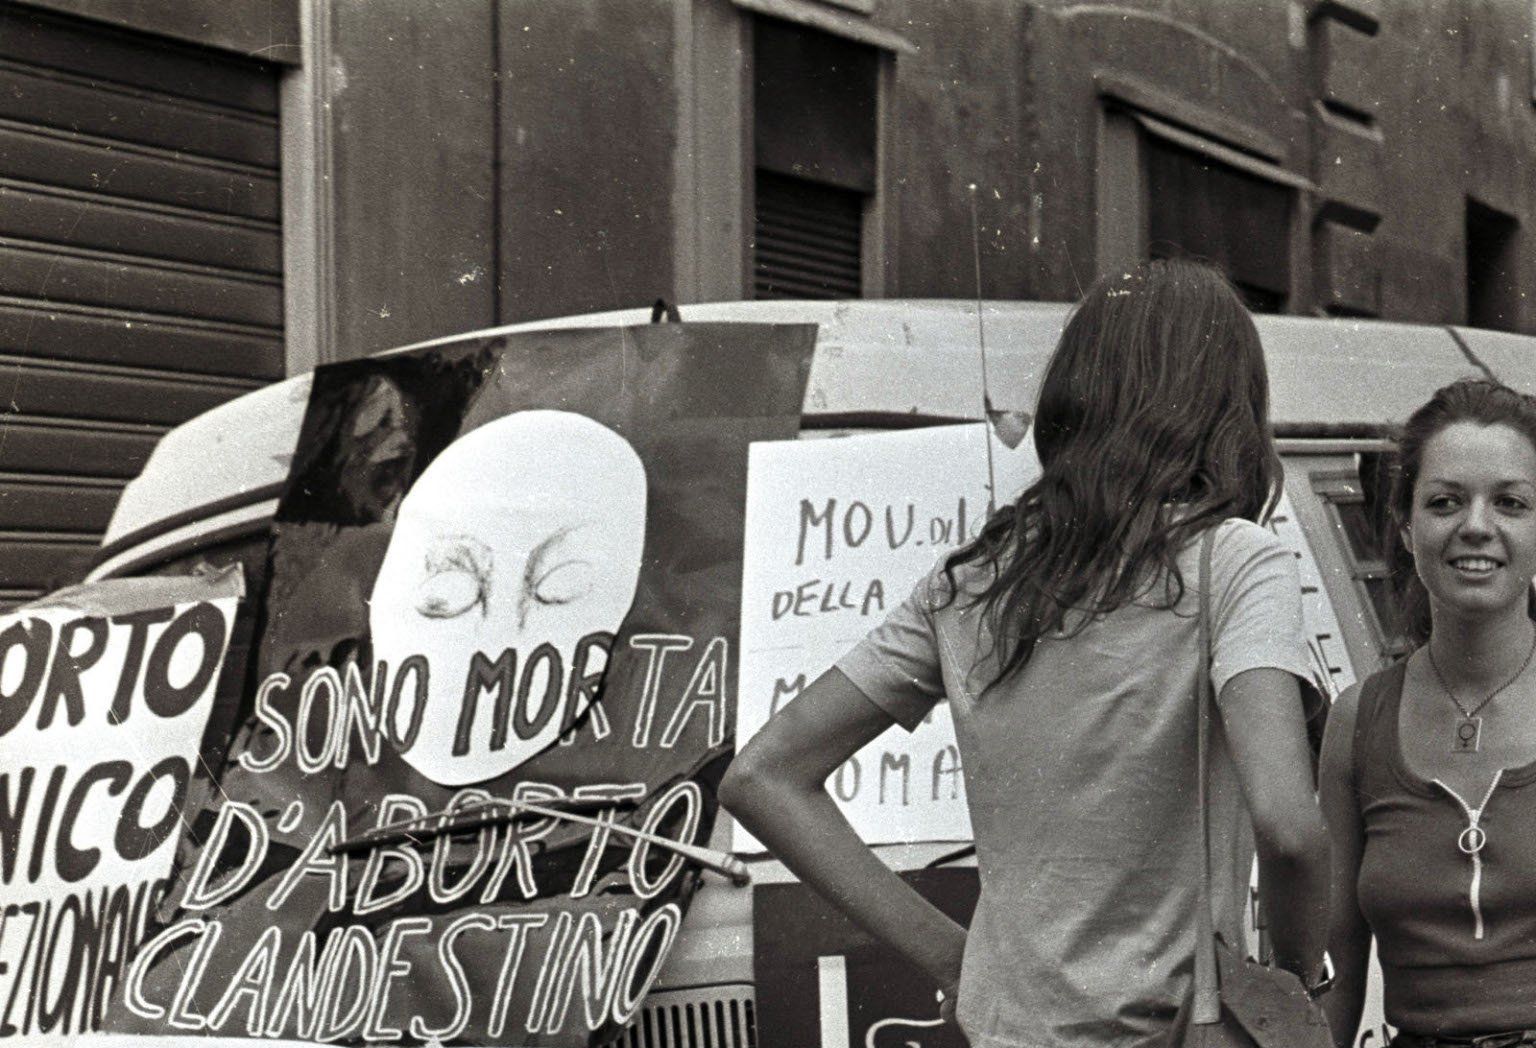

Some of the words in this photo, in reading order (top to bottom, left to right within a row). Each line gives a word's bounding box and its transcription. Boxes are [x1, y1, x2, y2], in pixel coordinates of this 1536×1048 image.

[772, 579, 884, 621] DELLA
[239, 654, 430, 773] SONO
[452, 631, 729, 756] MORTA
[834, 745, 963, 806] OMA
[180, 781, 702, 914] D'ABORTO
[124, 903, 681, 1043] CLANDESTINO
